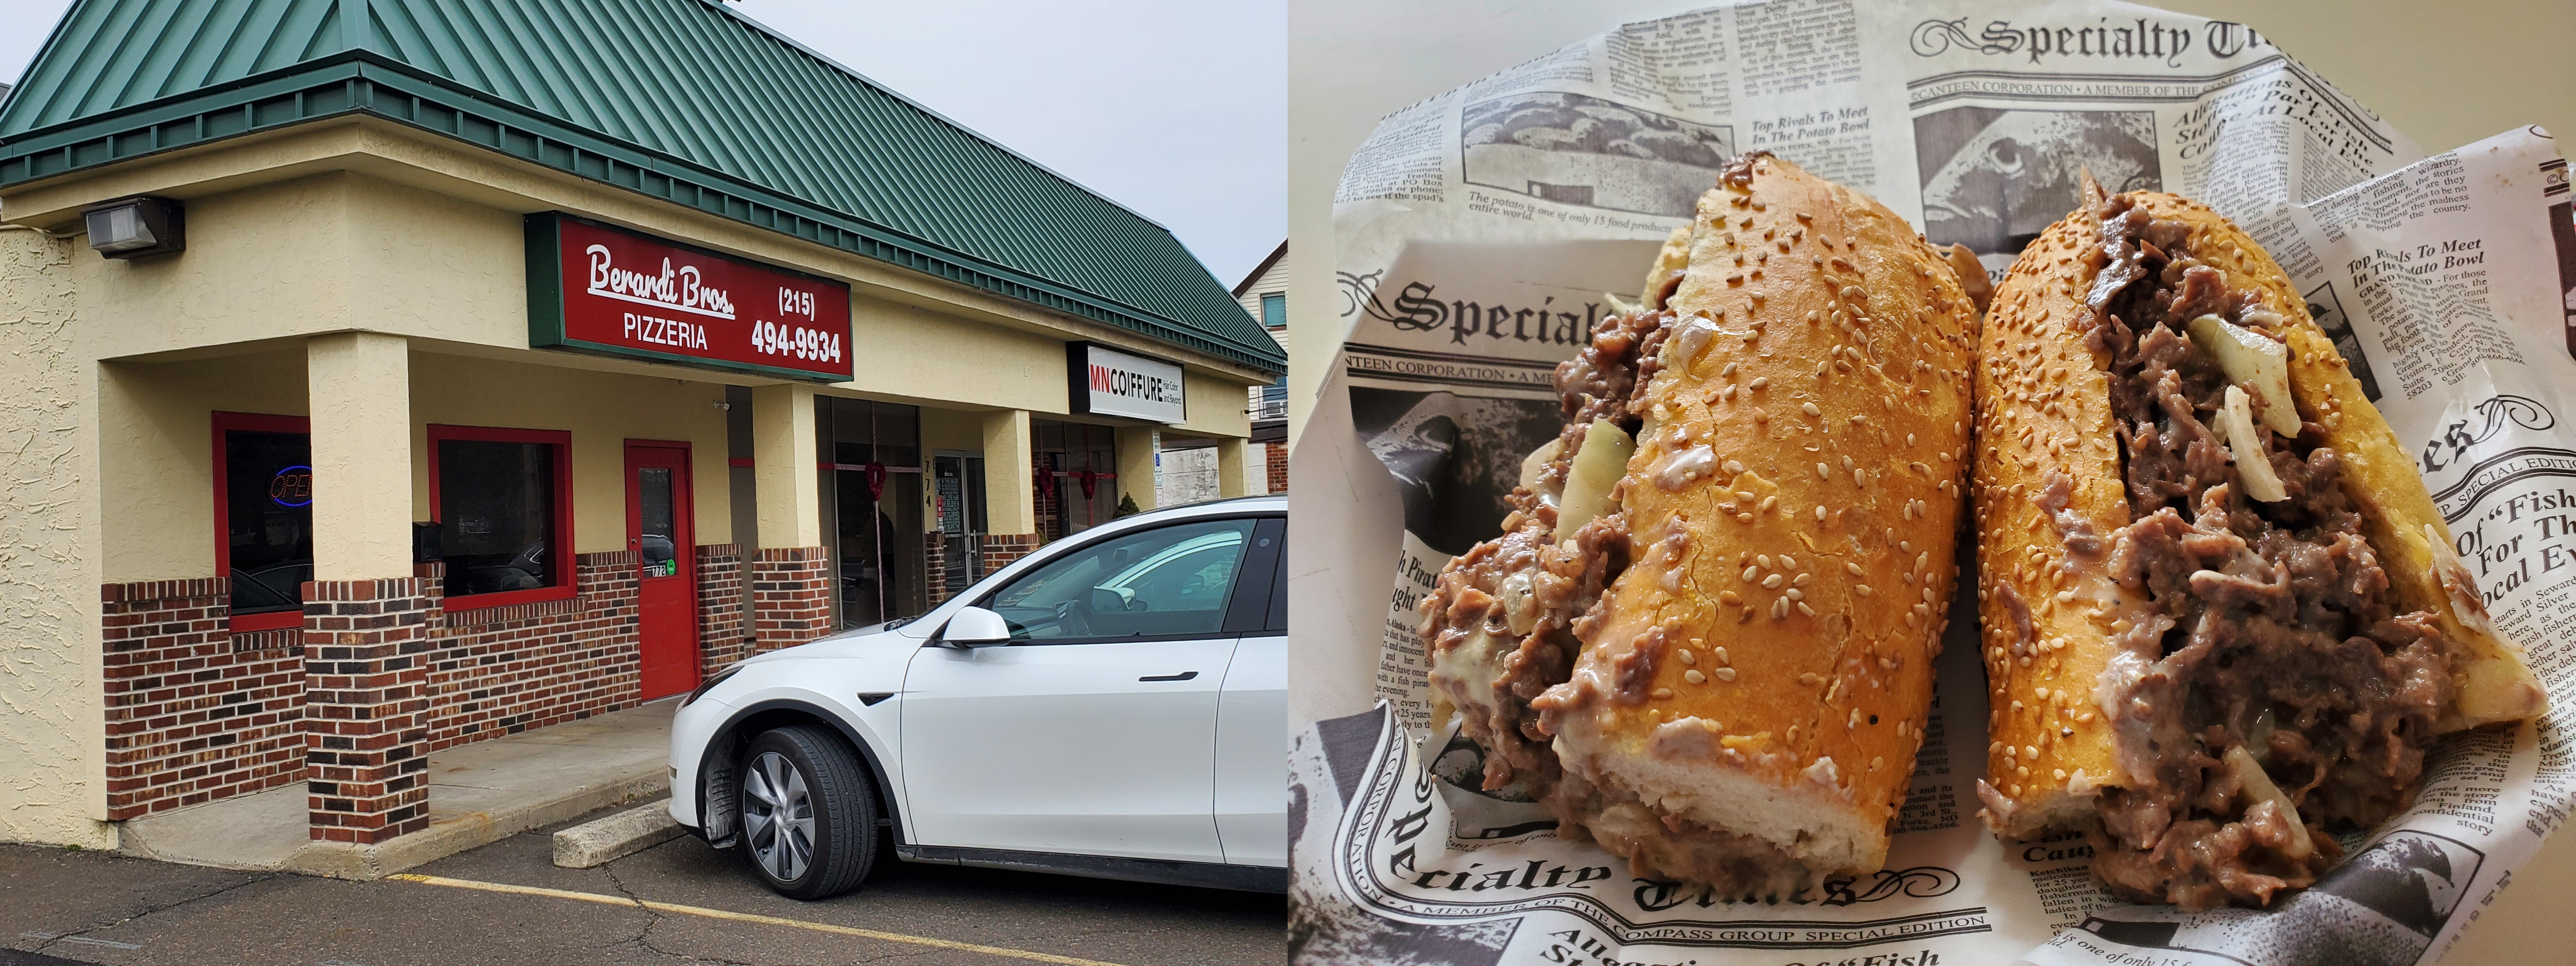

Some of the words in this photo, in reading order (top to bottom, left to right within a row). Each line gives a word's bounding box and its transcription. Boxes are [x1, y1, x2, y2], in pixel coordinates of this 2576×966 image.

[1981, 18, 2190, 68] Specialty
[1983, 82, 2073, 95] CORPORATION
[2084, 86, 2093, 95] A
[2096, 86, 2150, 96] MEMBER
[2155, 86, 2171, 96] OF
[2174, 86, 2199, 96] THE
[2300, 90, 2322, 109] Of
[1753, 121, 1773, 133] Top
[1778, 114, 1814, 128] Rivals
[1820, 111, 1834, 123] To
[1838, 107, 1868, 120] Meet
[2283, 106, 2333, 148] Local
[1753, 135, 1766, 145] In
[1771, 132, 1793, 143] The
[1798, 128, 1836, 139] Potato
[1840, 119, 1869, 133] Bowl
[2308, 109, 2337, 135] For
[2343, 137, 2373, 167] The
[2241, 166, 2287, 181] Mississippi
[2373, 179, 2405, 198] fishing
[2419, 158, 2461, 175] wizardry.
[2415, 175, 2429, 186] the
[2433, 166, 2464, 177] stories
[2247, 182, 2286, 198] bareback!
[2331, 193, 2360, 209] daring
[2362, 171, 2404, 194] challenge
[2405, 188, 2420, 199] nor
[2425, 180, 2439, 189] are
[2444, 176, 2465, 186] they
[2308, 197, 2334, 212] books
[2401, 193, 2428, 209] seems
[2455, 185, 2467, 194] no
[1469, 192, 1489, 203] The
[1491, 198, 1525, 210] potato
[1538, 208, 1554, 217] one
[1558, 211, 1568, 222] of
[1569, 213, 1590, 225] only
[1594, 215, 1605, 225] 15
[1607, 217, 1629, 229] food
[1630, 222, 1672, 233] products
[1469, 204, 1499, 215] entire
[1503, 210, 1534, 222] world.
[2247, 211, 2263, 222] with
[2371, 209, 2408, 226] stopping
[2411, 202, 2425, 211] the
[2429, 194, 2468, 205] madness
[2409, 211, 2424, 220] the
[2433, 203, 2471, 213] country.
[2272, 216, 2292, 231] grew
[2283, 223, 2296, 234] and
[2347, 256, 2370, 276] Top
[2376, 249, 2410, 262] Rivals
[2418, 245, 2435, 259] To
[2441, 238, 2481, 254] Meet
[2304, 265, 2323, 280] story
[2353, 273, 2368, 289] In
[2371, 261, 2397, 276] The
[2399, 263, 2438, 275] Potato
[2444, 251, 2484, 270] Bowl
[587, 244, 678, 303] Berardi
[680, 265, 734, 314] Bros.
[778, 287, 815, 321] (215)
[2359, 275, 2395, 298] GRAND
[2461, 270, 2486, 279] those
[2368, 295, 2393, 315] annual
[2459, 287, 2488, 298] Grand
[1394, 281, 1612, 346] Special
[2370, 306, 2393, 322] Forks
[2389, 314, 2414, 332] potato
[624, 313, 707, 350] PIZZERIA
[752, 320, 840, 363] 494-9934
[2393, 350, 2418, 369] highly
[2396, 357, 2422, 375] Grand
[1396, 362, 1505, 380] CORPORATION
[2399, 362, 2432, 383] Visitors
[1170, 381, 1178, 392] Color
[2403, 376, 2425, 392] Suite
[2407, 381, 2432, 400] 58203
[2448, 374, 2466, 385] call:
[1170, 394, 1181, 406] Beyond
[2458, 462, 2522, 506] SPECIAL
[2456, 518, 2483, 557] Of
[2478, 534, 2523, 578] For
[653, 566, 665, 576] 772
[2481, 557, 2530, 609] ocal
[2536, 592, 2568, 612] Silver
[2494, 607, 2516, 625] starts
[2520, 599, 2532, 608] in
[1390, 619, 1406, 631] Alaska
[1390, 630, 1398, 640] that
[1400, 633, 1409, 642] has
[1389, 642, 1398, 650] and
[1399, 644, 1425, 656] innocent
[2527, 639, 2553, 659] great
[1380, 661, 1395, 672] father
[1396, 666, 1410, 675] have
[1404, 656, 1415, 665] her
[1398, 676, 1409, 685] fish
[1382, 686, 1409, 697] evening.
[1400, 700, 1421, 710] every
[2540, 746, 2573, 761] Trout
[2439, 803, 2495, 814] Finland.
[2464, 798, 2496, 806] from
[1901, 819, 1932, 827] Forks,
[2457, 819, 2493, 836] story
[1352, 757, 1397, 901] CORPORATION
[1423, 904, 1526, 915] MEMBER
[1571, 901, 1610, 925] THE
[1613, 925, 1713, 940] COMPASS
[1720, 931, 1795, 941] GROUP
[1806, 928, 1894, 941] SPECIAL
[1898, 916, 1985, 934] EDITION
[2030, 866, 2088, 877] Ketchikan
[2037, 883, 2087, 895] daughter
[2040, 888, 2097, 901] fisherman
[2042, 899, 2075, 907] fallen
[2044, 906, 2078, 914] ladies
[2077, 941, 2104, 955] one
